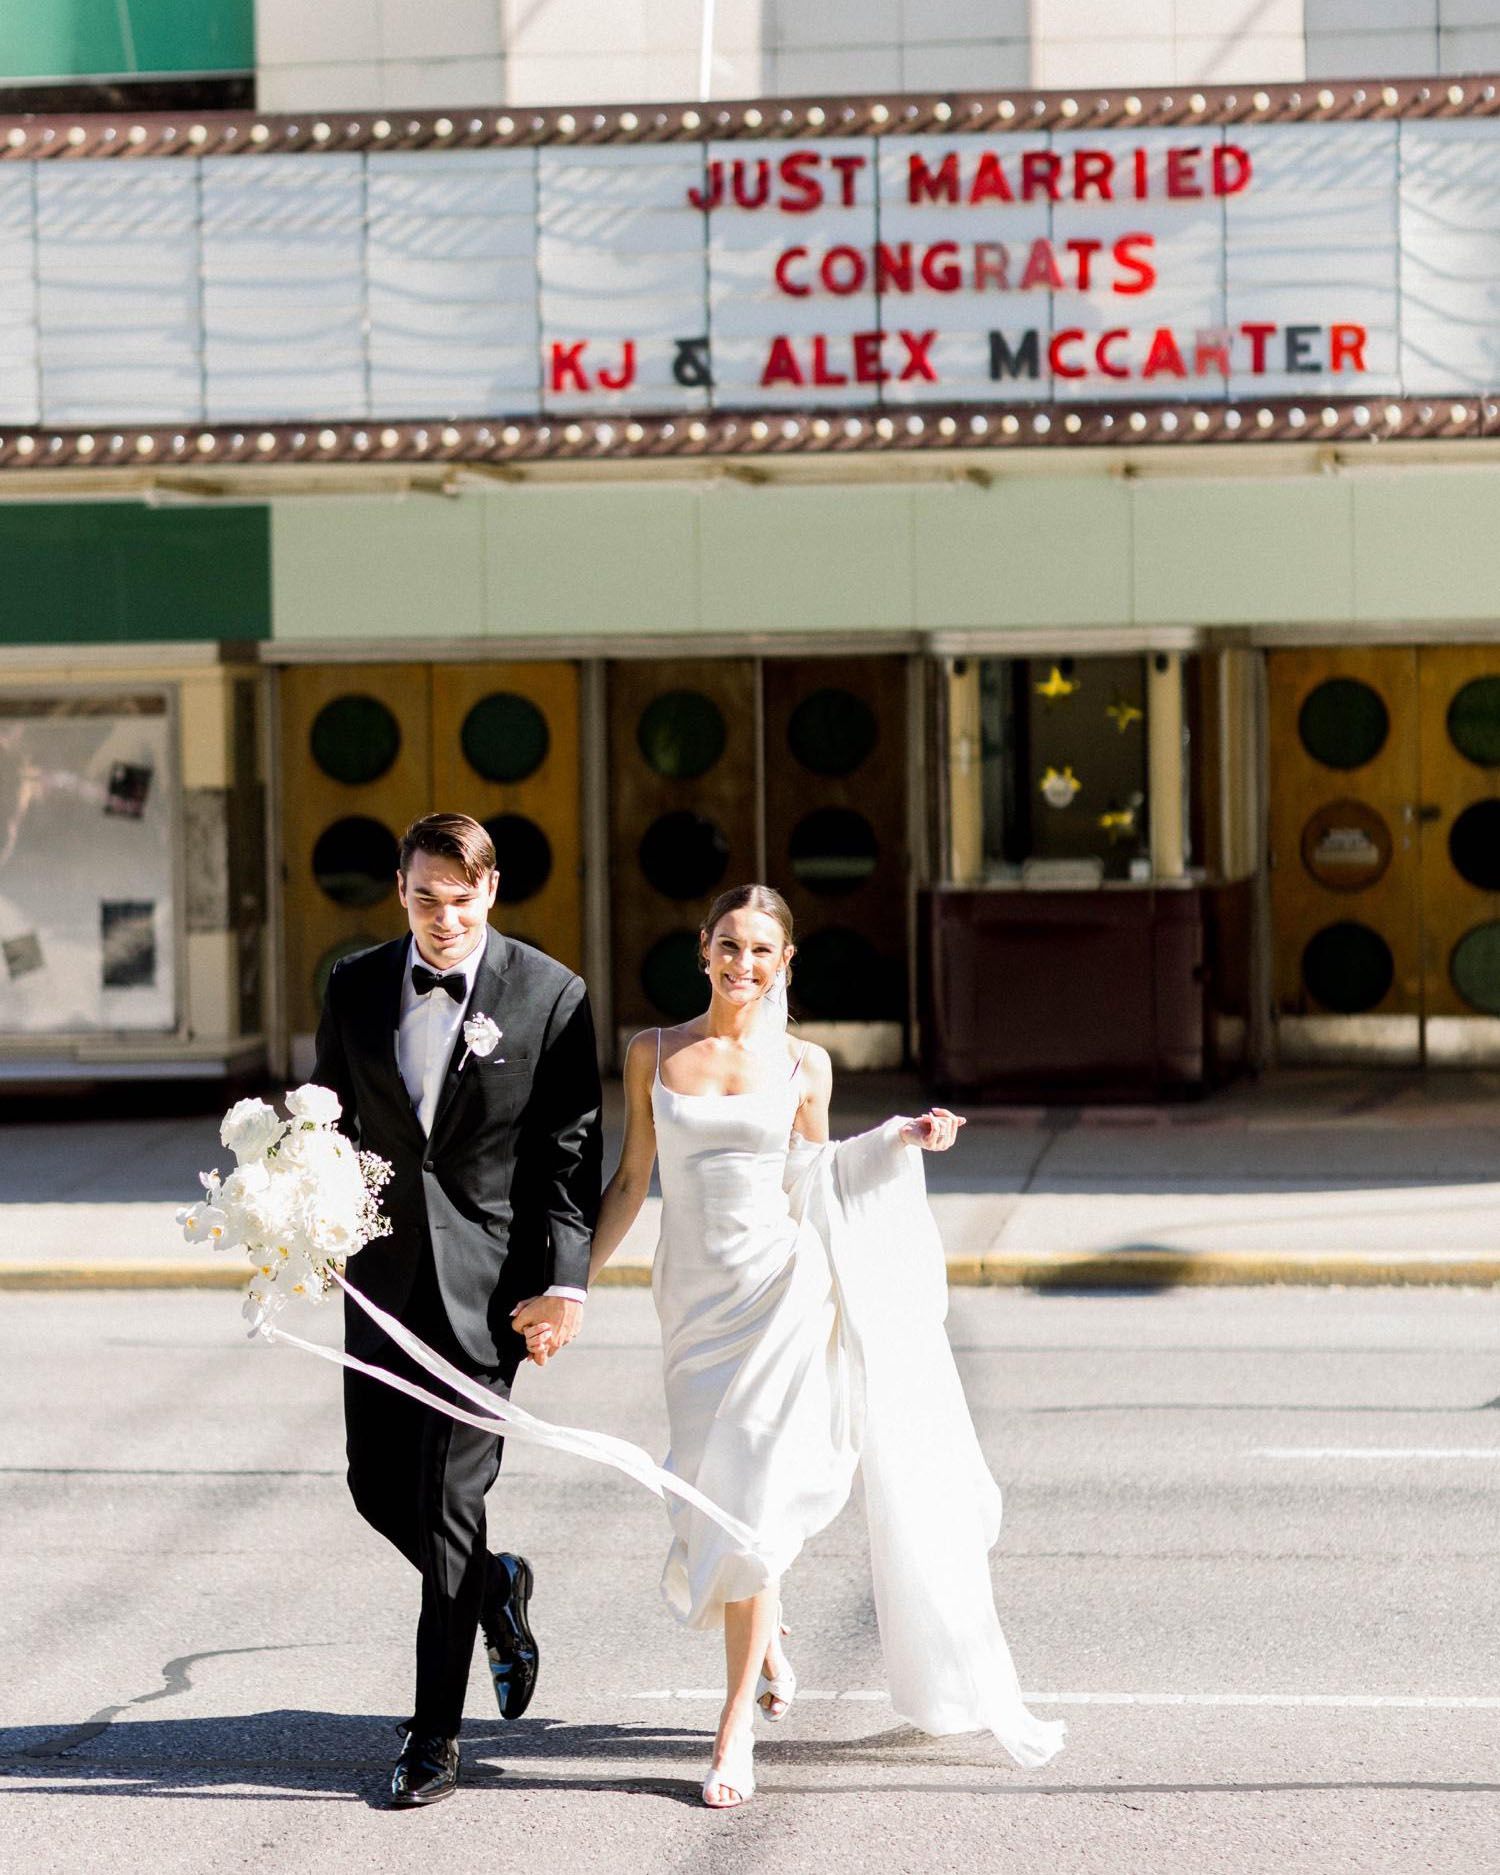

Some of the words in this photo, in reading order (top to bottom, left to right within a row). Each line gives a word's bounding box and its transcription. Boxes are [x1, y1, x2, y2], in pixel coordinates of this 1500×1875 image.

[687, 150, 866, 213] JUST
[908, 145, 1252, 206] MARRIED
[775, 233, 1156, 296] CONGRATS
[550, 339, 637, 392] KJ
[673, 336, 713, 387] &
[761, 330, 937, 387] ALEX
[988, 322, 1367, 381] MCCARTER
